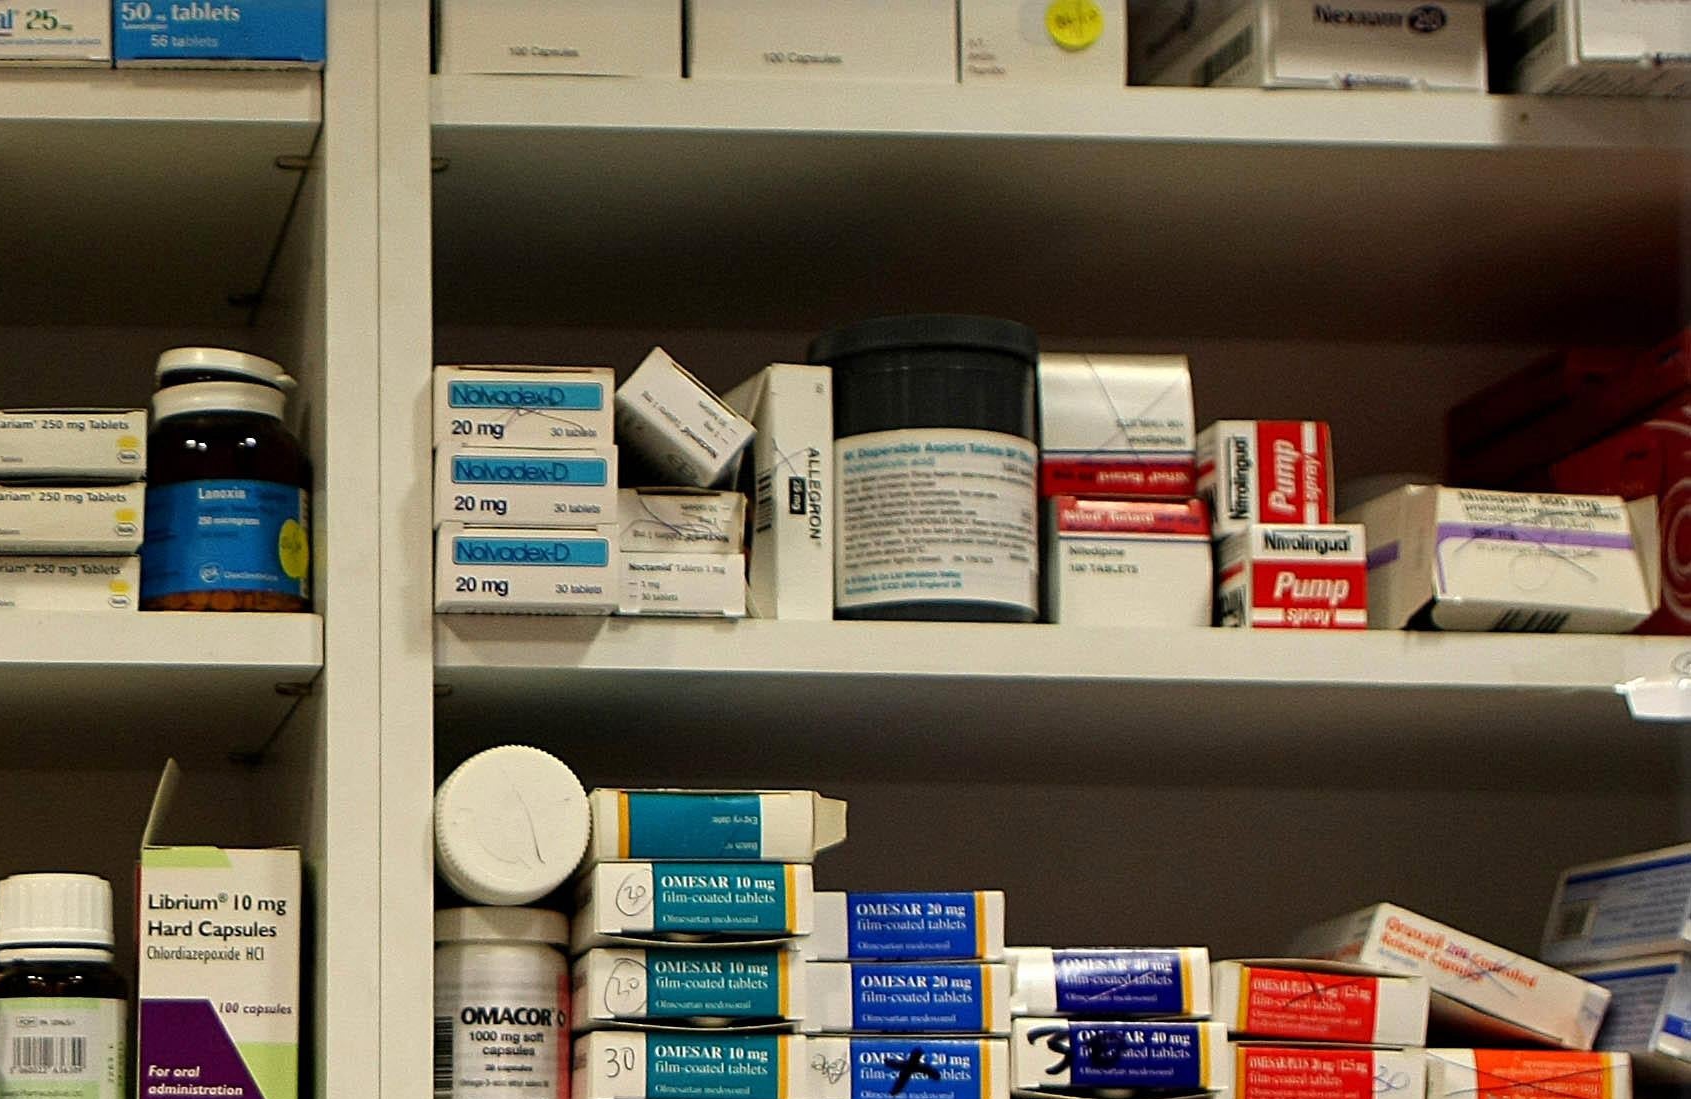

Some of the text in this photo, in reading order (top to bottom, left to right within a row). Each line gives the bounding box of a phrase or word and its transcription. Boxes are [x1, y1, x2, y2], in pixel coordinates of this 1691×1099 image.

[26, 10, 58, 30] 25
[122, 1, 240, 21] 50 tablets
[151, 35, 218, 47] 56 tablets
[452, 384, 565, 406] Nolvadex-D
[41, 420, 64, 429] 250
[67, 421, 85, 431] mg
[89, 419, 129, 430] Tablets
[452, 420, 505, 439] 20 mg
[1269, 439, 1296, 514] Pump
[809, 447, 821, 541] ALLEGRON
[555, 503, 601, 514] 30 tablets
[1274, 572, 1350, 605] Pump
[1284, 607, 1330, 625] spray
[662, 876, 775, 891] OMESAR 10 mg
[148, 894, 286, 915] Librium 10 mg
[148, 921, 277, 940] Hard Capsules
[147, 946, 240, 963] Chlordiazepoxide
[219, 1004, 292, 1015] 100 capsules
[460, 1007, 552, 1026] OMACOR
[468, 1031, 544, 1043] 1000 mg soft
[483, 1045, 536, 1058] capsules
[148, 1066, 200, 1077] For oral
[607, 1048, 636, 1078] 30
[148, 1084, 243, 1096] administration
